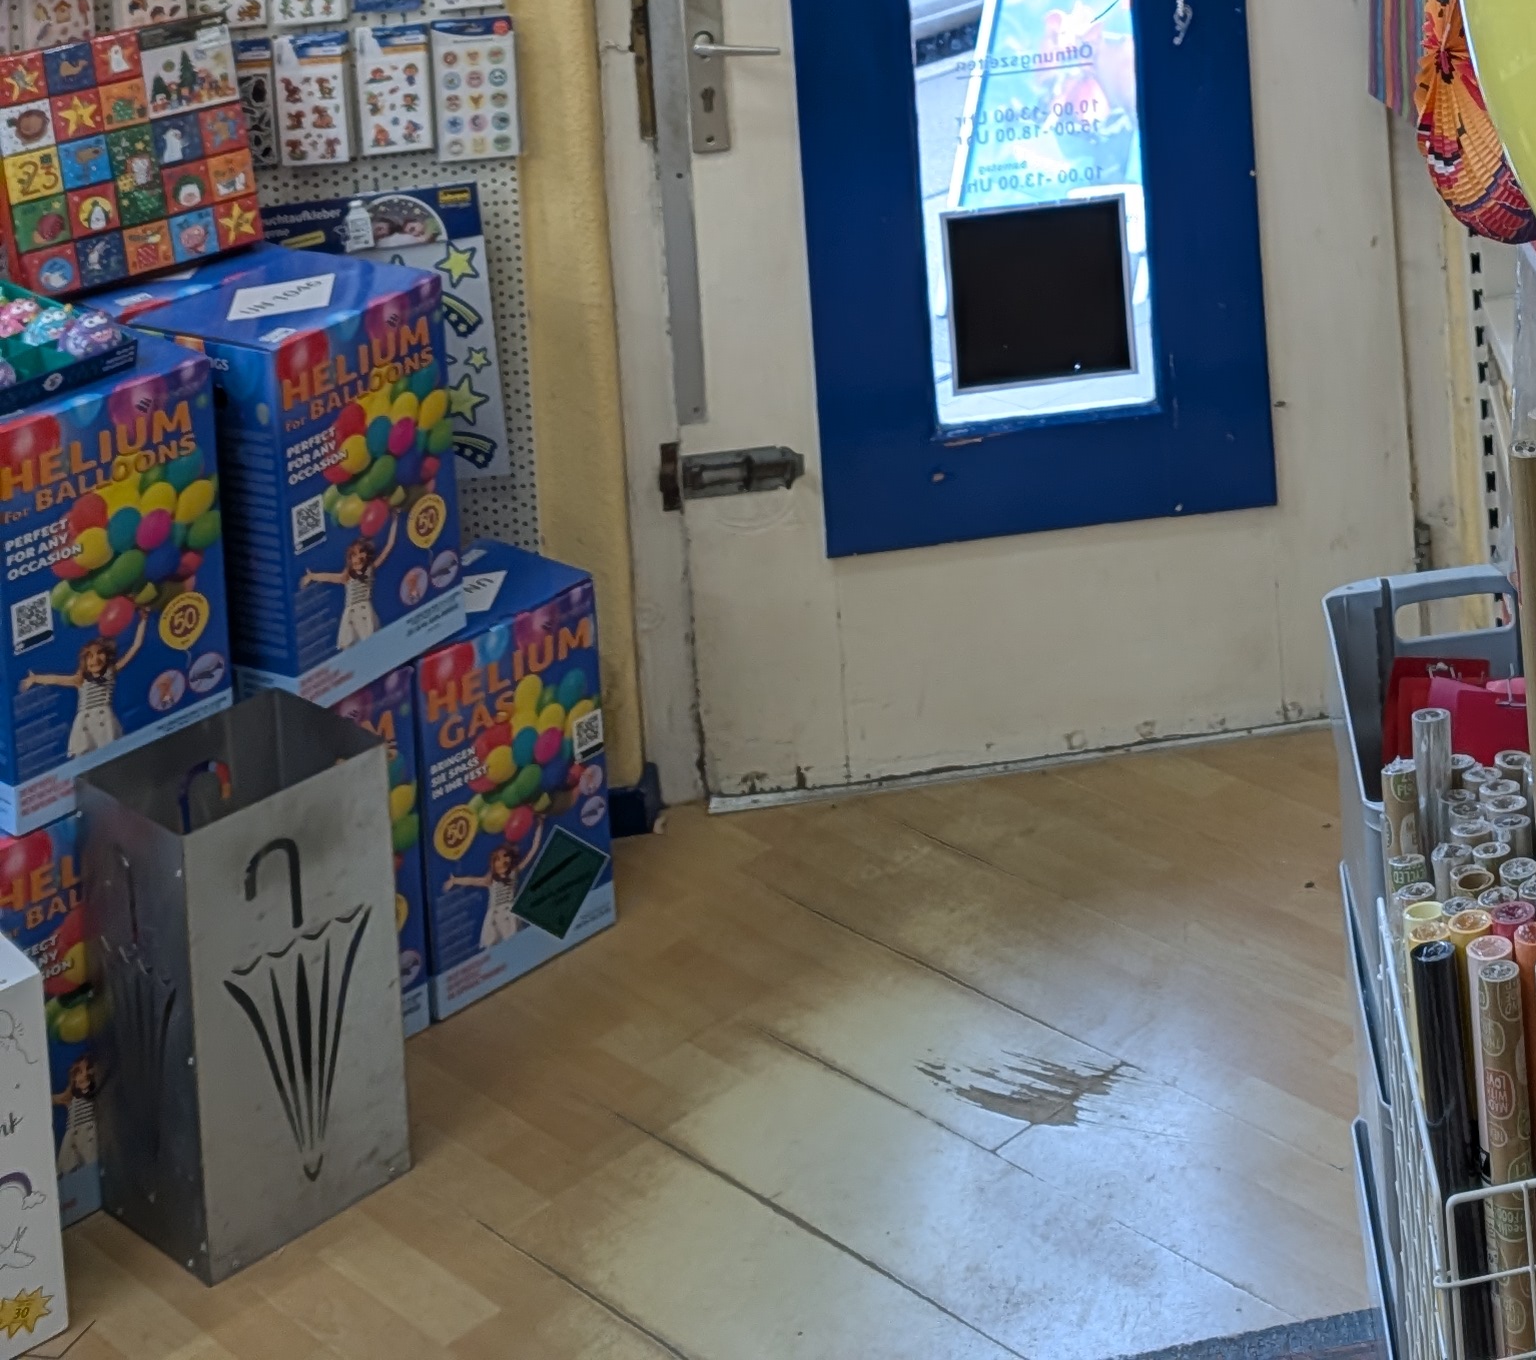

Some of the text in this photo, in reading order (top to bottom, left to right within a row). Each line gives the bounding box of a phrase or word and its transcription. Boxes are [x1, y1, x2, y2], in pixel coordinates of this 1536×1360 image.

[263, 208, 341, 228] uchtaufkleber
[282, 316, 430, 410] HELIUM
[310, 346, 434, 421] BALLOONS
[0, 400, 192, 502] HELIUM
[286, 426, 337, 459] PERFECT
[287, 440, 338, 472] FOR ANY
[35, 431, 196, 513] BALLOONS
[288, 448, 348, 485] OCCASION
[5, 518, 69, 551] PERFECT
[6, 533, 69, 567] FOR ANY
[7, 543, 82, 581] OCCASION
[427, 617, 592, 722] HELIUM
[439, 691, 516, 750] GAS
[0, 855, 80, 910] HEL
